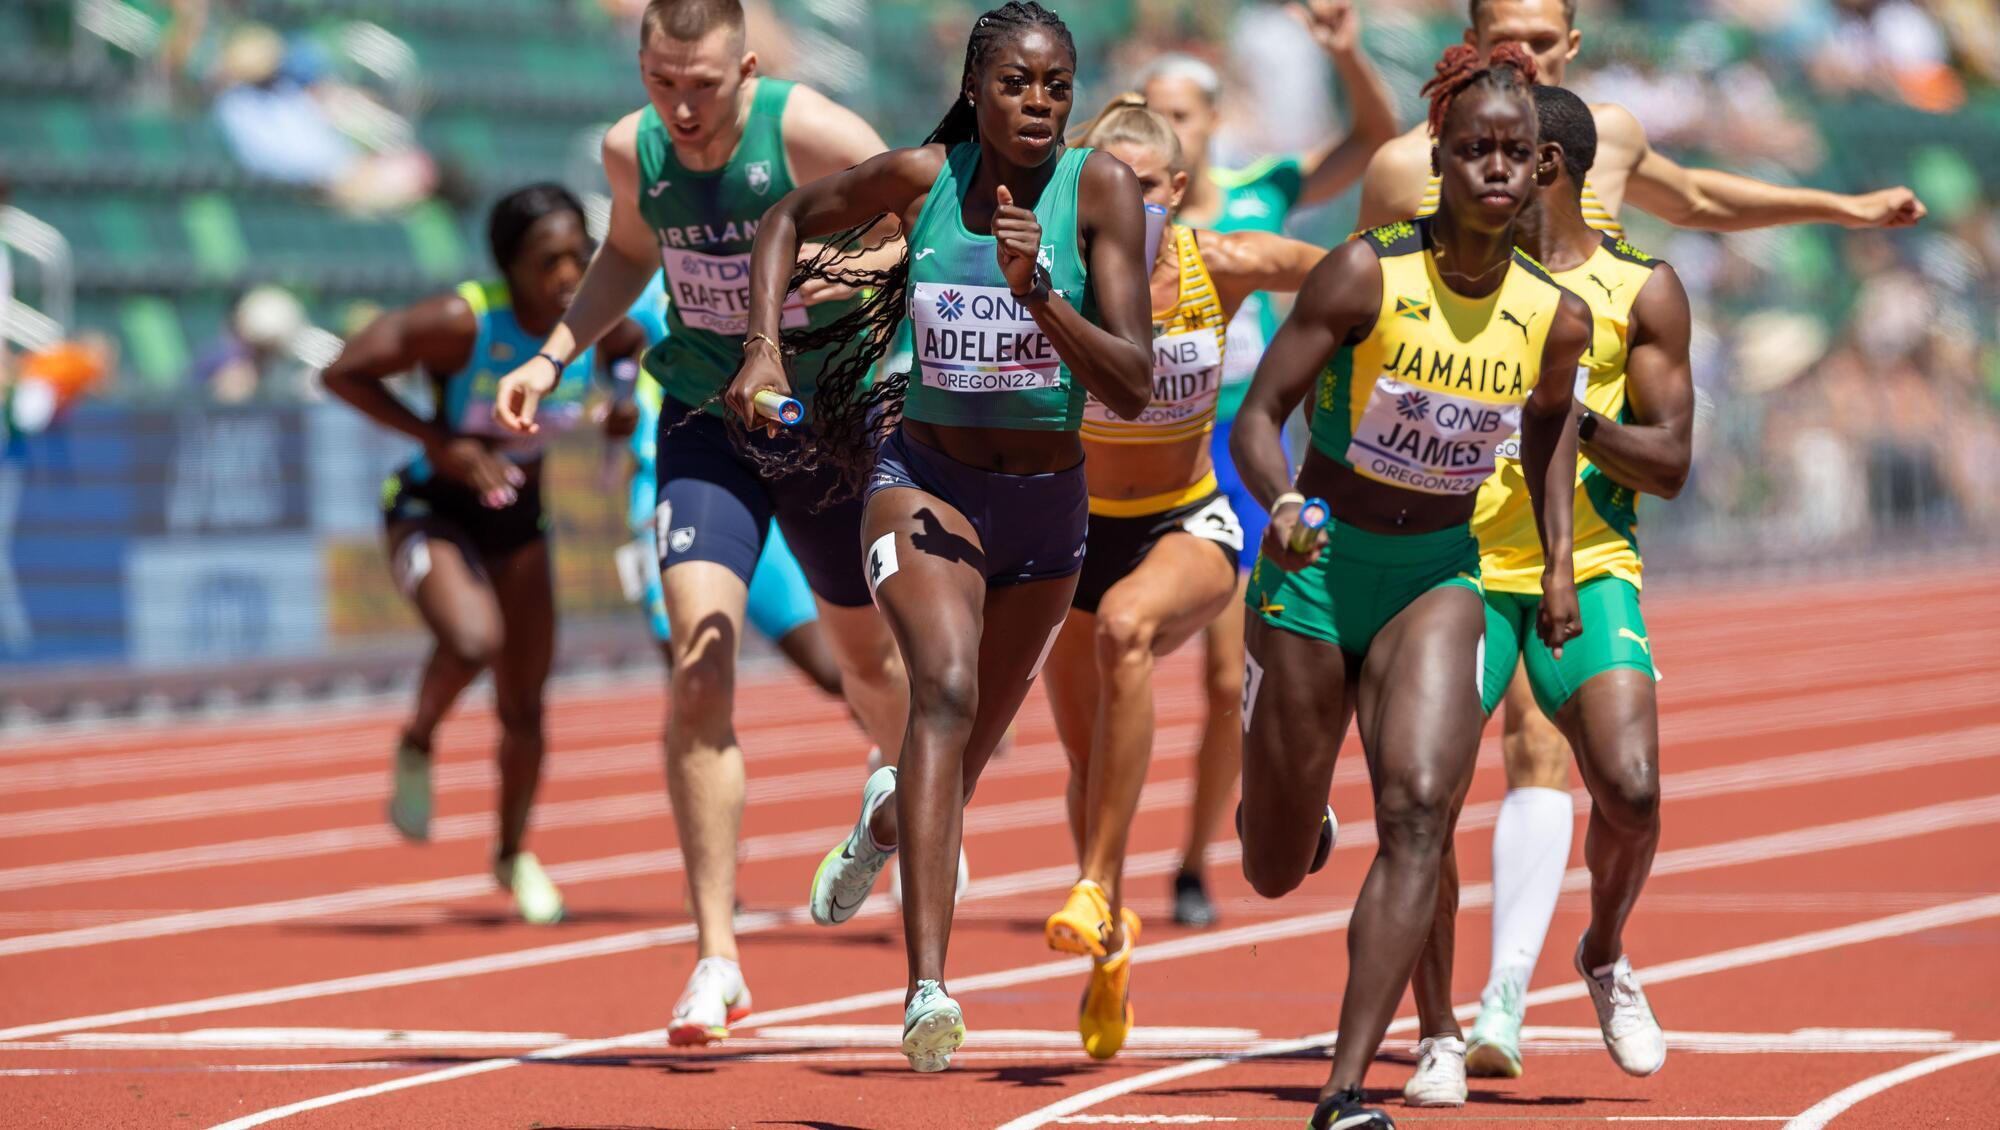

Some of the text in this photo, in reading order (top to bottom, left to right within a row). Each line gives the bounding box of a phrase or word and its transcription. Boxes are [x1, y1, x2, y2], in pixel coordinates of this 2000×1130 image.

[659, 220, 759, 247] IRELAN
[679, 282, 750, 311] RAFTE
[924, 327, 1051, 363] ADELEKE
[1153, 341, 1198, 365] NB
[937, 372, 1036, 389] OREGON22
[1382, 343, 1523, 396] JAMAICA
[1153, 369, 1212, 401] MIDT
[1436, 404, 1501, 433] QNB
[1378, 424, 1487, 468] JAMES
[1371, 459, 1474, 491] OREGON22
